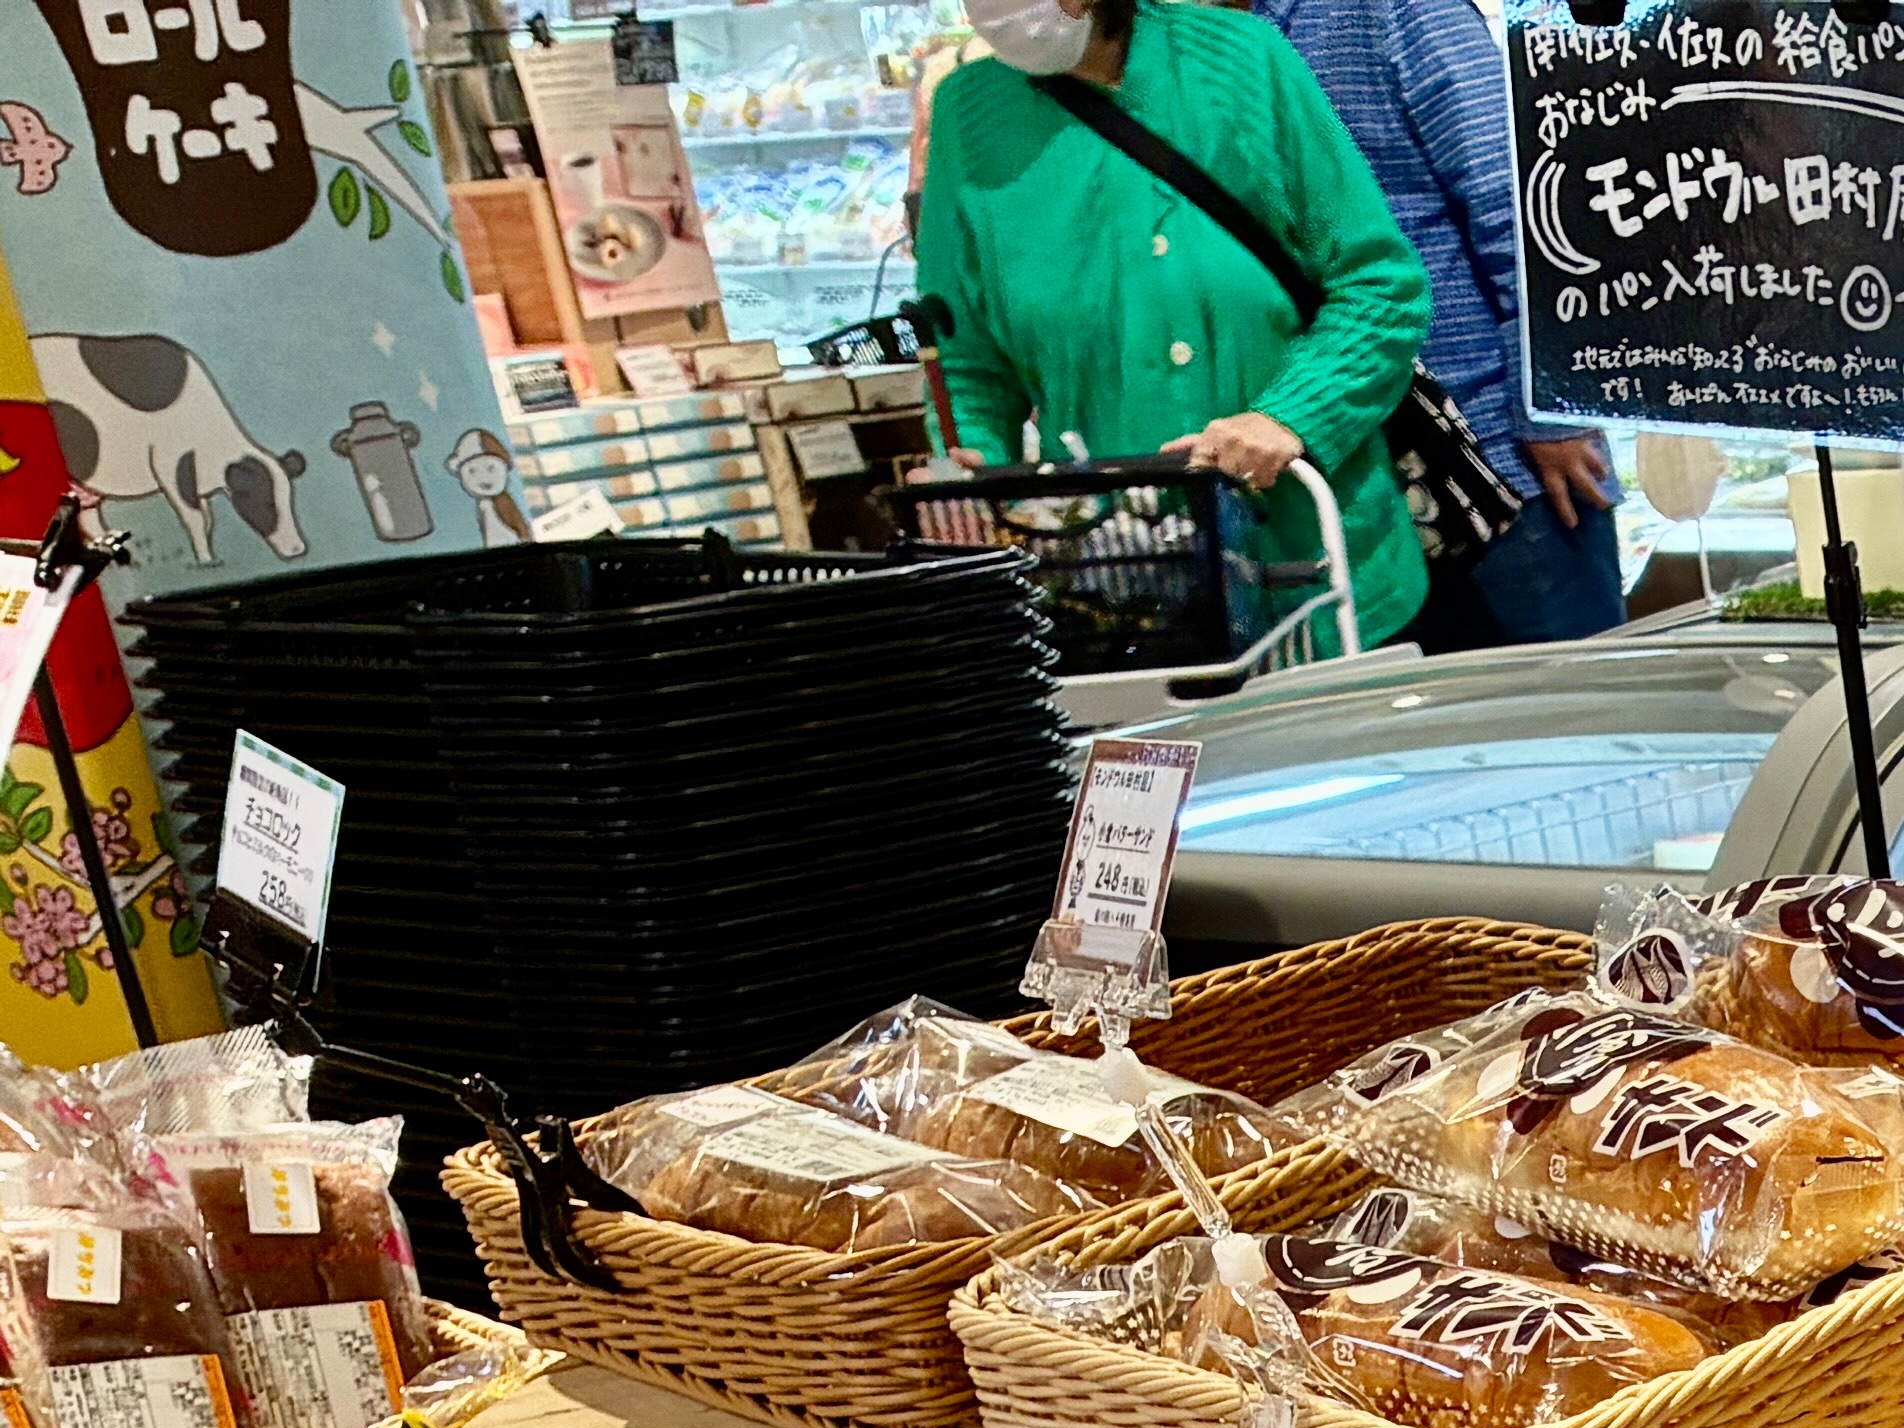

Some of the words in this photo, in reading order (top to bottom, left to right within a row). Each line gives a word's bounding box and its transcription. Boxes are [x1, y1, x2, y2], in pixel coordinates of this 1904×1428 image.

[125, 82, 279, 184] ケーキ
[1536, 78, 1657, 148] おなじみ
[1556, 244, 1834, 323] のパン入荷しました
[1592, 1072, 1793, 1169] サンド
[1389, 1269, 1633, 1353] サンド
